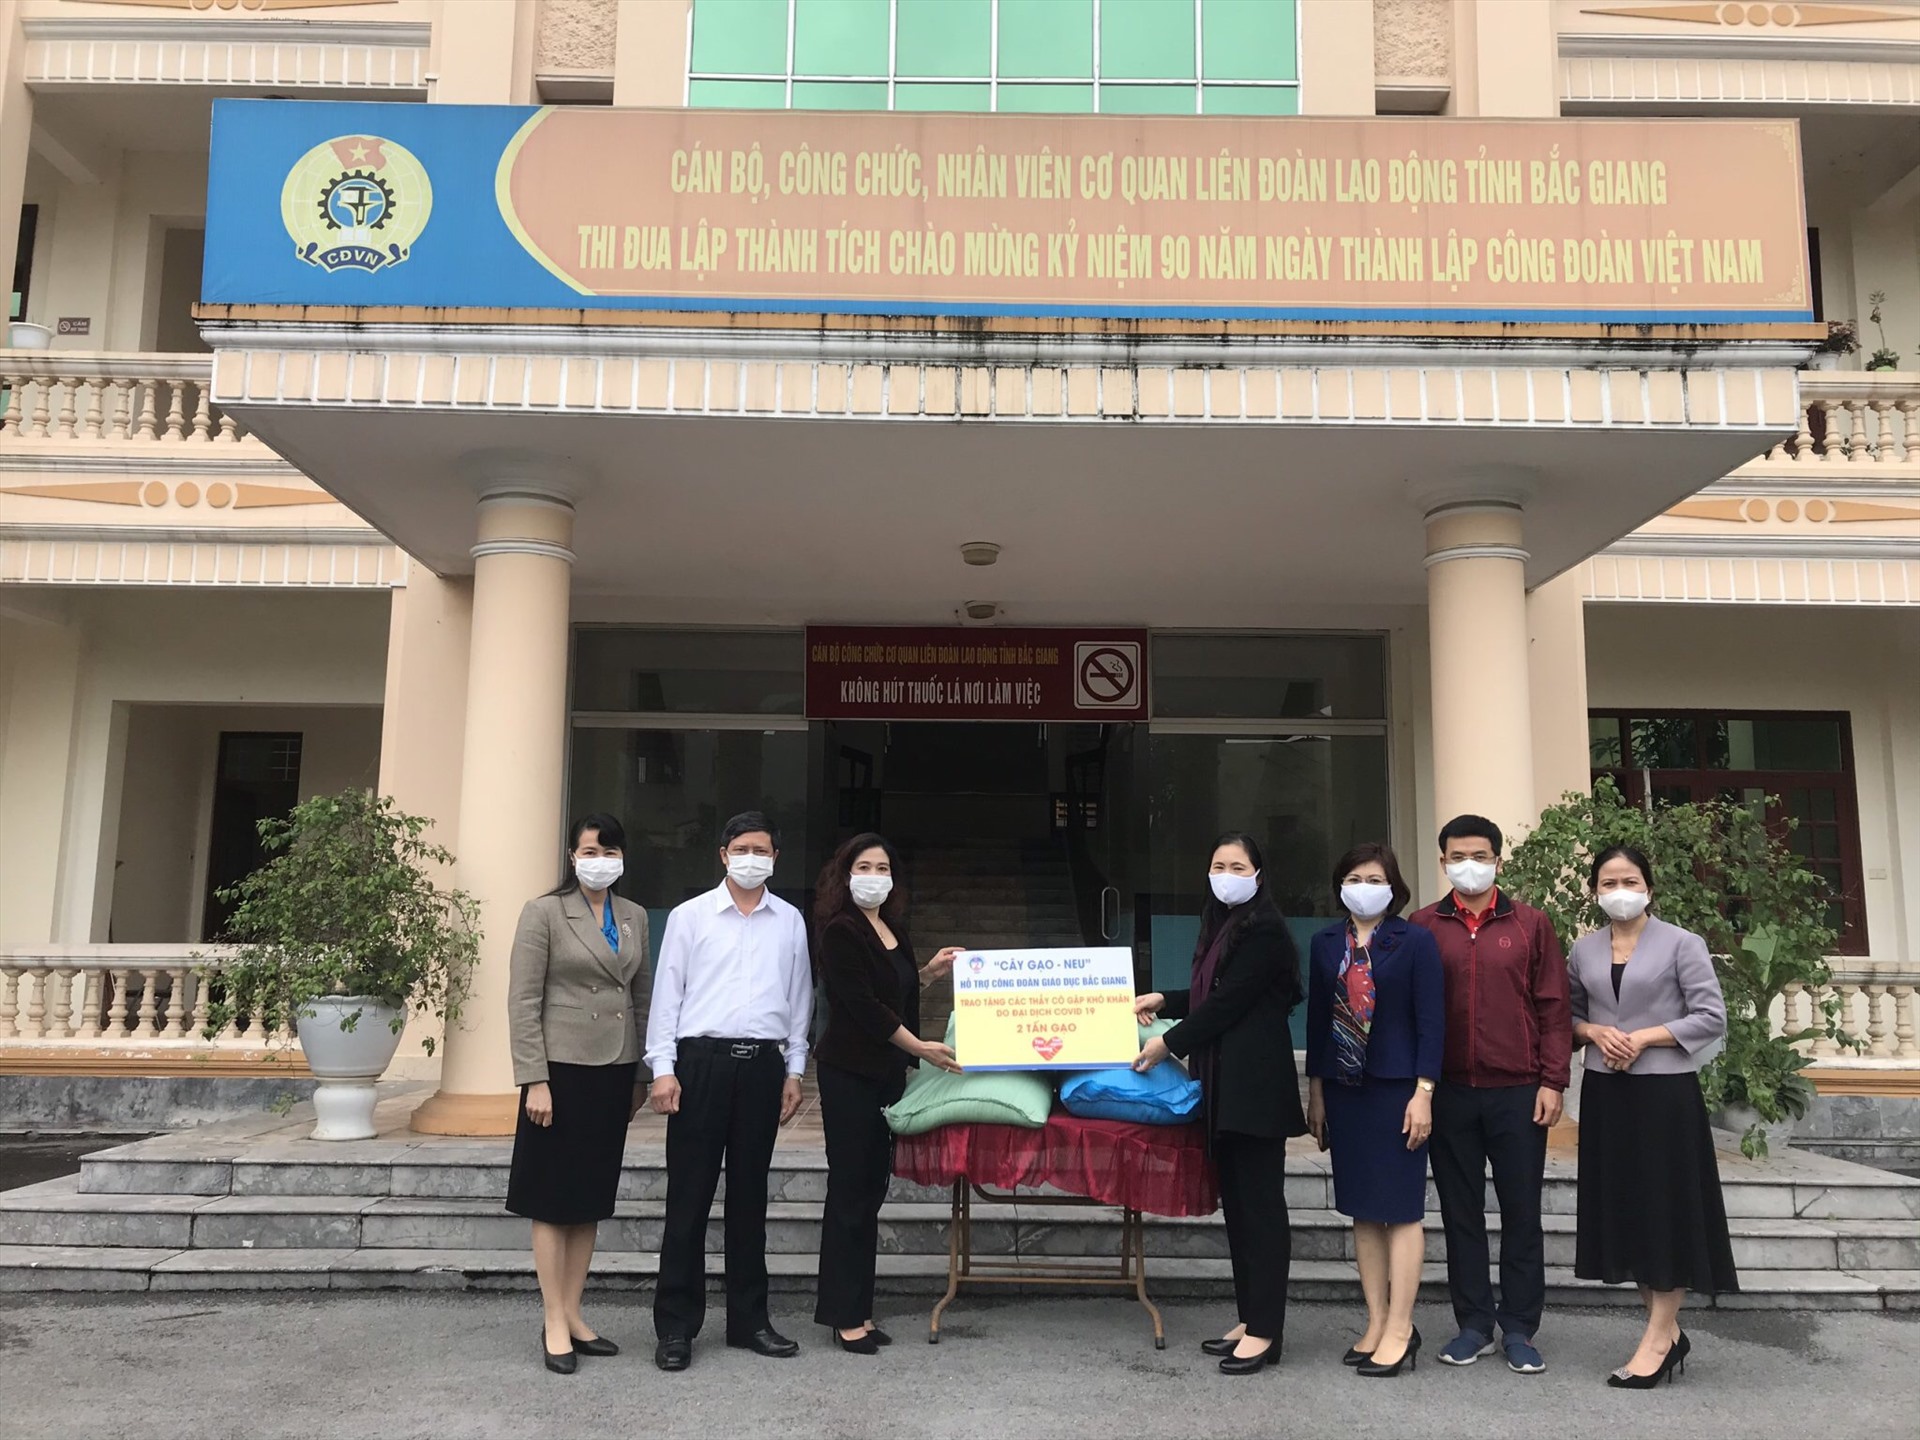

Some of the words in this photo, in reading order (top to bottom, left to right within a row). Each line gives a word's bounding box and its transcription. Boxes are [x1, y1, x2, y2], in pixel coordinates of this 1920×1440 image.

[671, 140, 722, 193] CÁN
[730, 142, 770, 204] BỘ,
[779, 142, 847, 196] CÔNG
[855, 143, 928, 203] CHỨC,
[937, 144, 1007, 198] NHÂN
[1015, 145, 1071, 199] VIÊN
[1080, 152, 1113, 200] CƠ
[1121, 156, 1188, 205] QUAN
[1196, 148, 1249, 201] LIÊN
[1258, 148, 1327, 202] ĐOÀN
[1335, 158, 1380, 203] LAO
[1388, 150, 1457, 213] ĐỘNG
[1464, 145, 1522, 204] TỈNH
[1530, 143, 1581, 205] BẮC
[1588, 160, 1667, 205] GIANG
[327, 249, 379, 266] CĐVN
[578, 225, 616, 269] THI
[624, 226, 672, 270] ĐUA
[680, 217, 728, 281] LẬP
[736, 219, 818, 272] THÀNH
[825, 220, 881, 274] TÍCH
[889, 222, 955, 276] CHÀO
[964, 223, 1039, 277] MỪNG
[1047, 217, 1080, 278] KỶ
[1087, 224, 1152, 289] NIỆM
[1160, 235, 1190, 280] 90
[1198, 226, 1257, 280] NĂM
[1265, 227, 1332, 281] NGÀY
[1340, 227, 1423, 282] THÀNH
[1431, 228, 1478, 292] LẬP
[1486, 229, 1555, 283] CÔNG
[1563, 229, 1634, 284] ĐOÀN
[1640, 230, 1694, 294] VIỆT
[1702, 239, 1764, 284] NAM
[886, 645, 897, 664] CƠ
[898, 646, 918, 665] QUAN
[961, 647, 975, 664] LAO
[1035, 647, 1059, 665] GIANG
[841, 675, 880, 703] KHÔNG
[883, 676, 904, 703] HÚT
[908, 674, 943, 704] THUỐC
[947, 677, 961, 704] LÁ
[964, 680, 984, 704] NƠI
[988, 677, 1011, 704] LÀM
[1015, 677, 1041, 709] VIỆC
[1027, 960, 1054, 972] GẠO
[991, 978, 1014, 988] CÔNG
[1063, 977, 1080, 988] DỤC
[1101, 976, 1127, 986] GIANG
[960, 998, 982, 1007] TRAO
[996, 1009, 1010, 1018] DO
[1030, 1008, 1052, 1018] DỊCH
[1054, 1007, 1082, 1016] COVID
[1085, 1007, 1096, 1016] 19
[1016, 1024, 1024, 1033] 2
[1026, 1020, 1048, 1033] TẤN
[1051, 1023, 1077, 1035] GẠO
